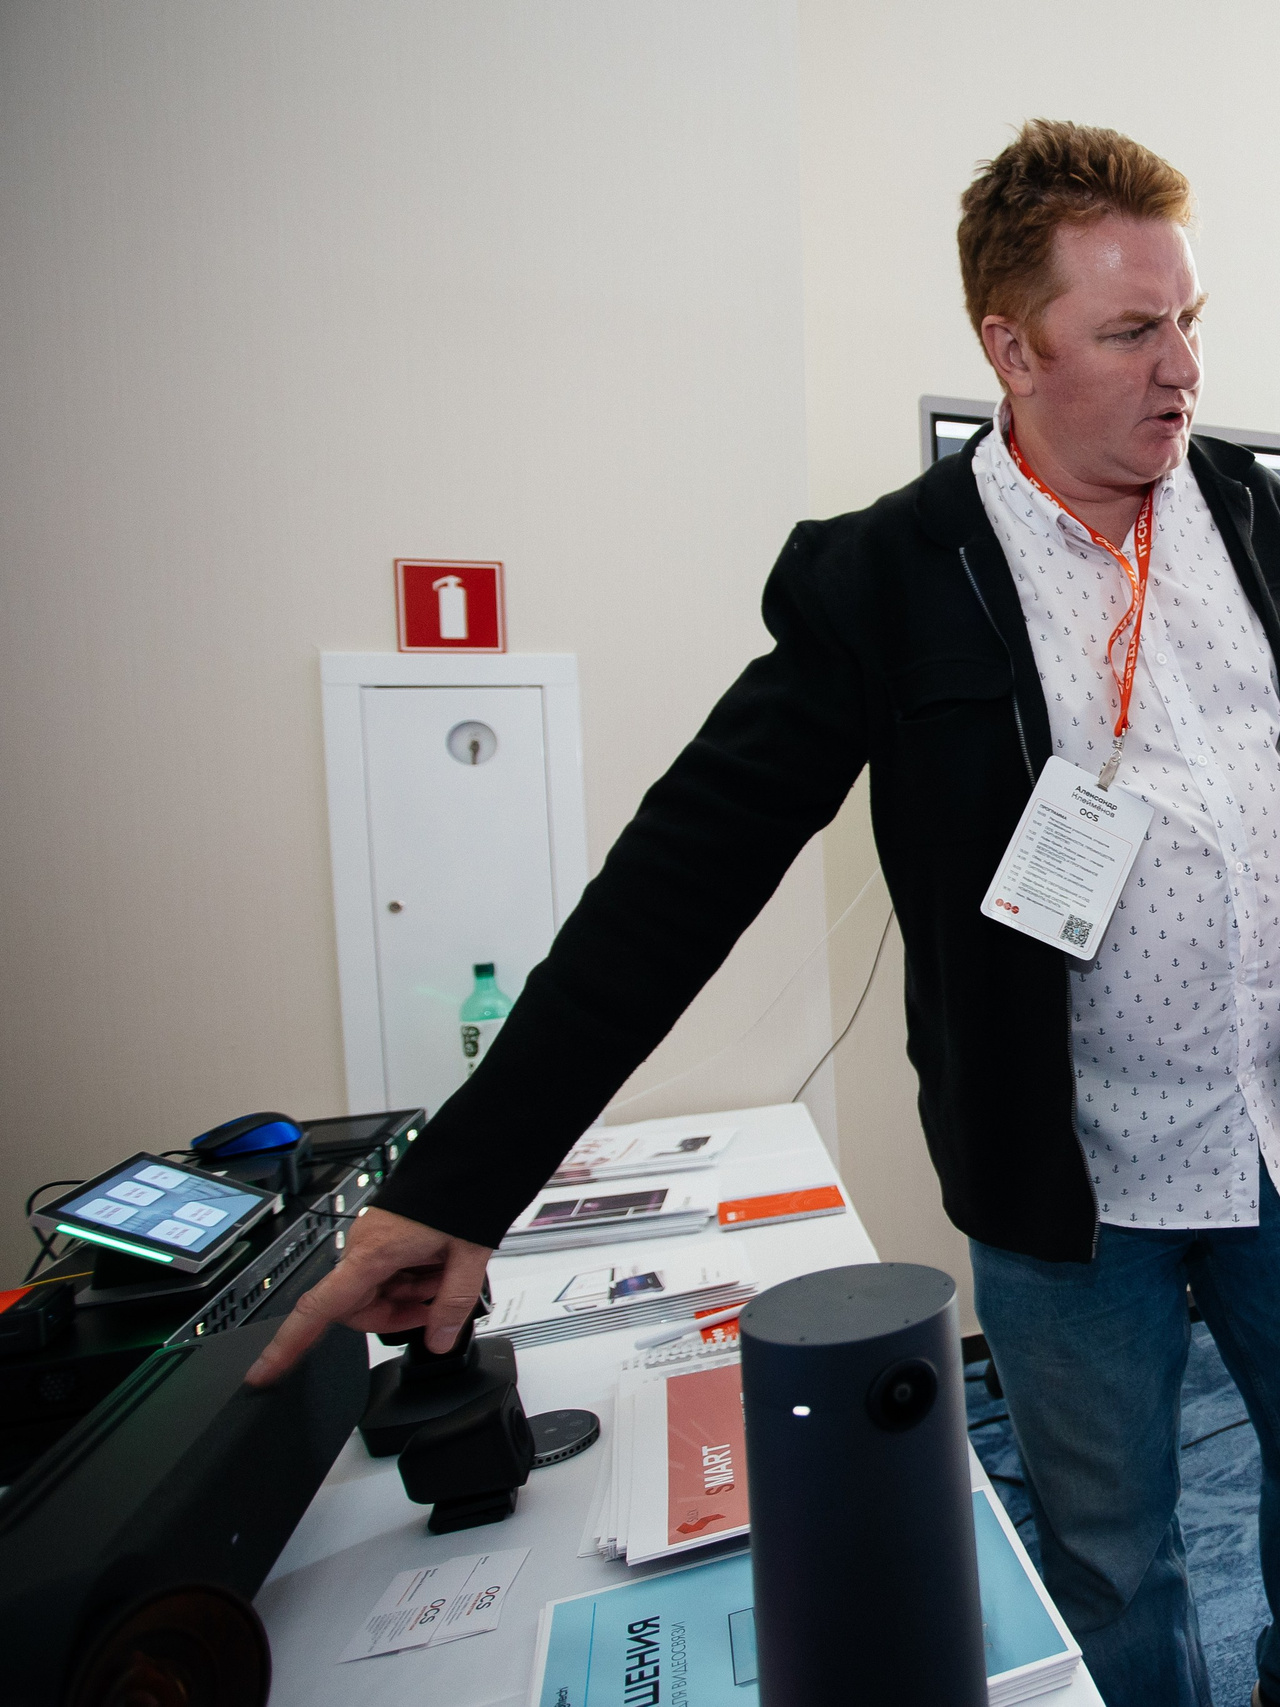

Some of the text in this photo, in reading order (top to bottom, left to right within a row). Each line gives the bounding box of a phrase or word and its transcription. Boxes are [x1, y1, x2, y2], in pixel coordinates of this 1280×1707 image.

[1095, 536, 1122, 557] OCS
[1075, 785, 1118, 811] Александр
[1080, 808, 1100, 822] OCS
[702, 1444, 735, 1495] SMART
[475, 1585, 501, 1610] OCS
[419, 1598, 446, 1625] OCS
[671, 1620, 687, 1690] ВИДЕОСВЯЗИ
